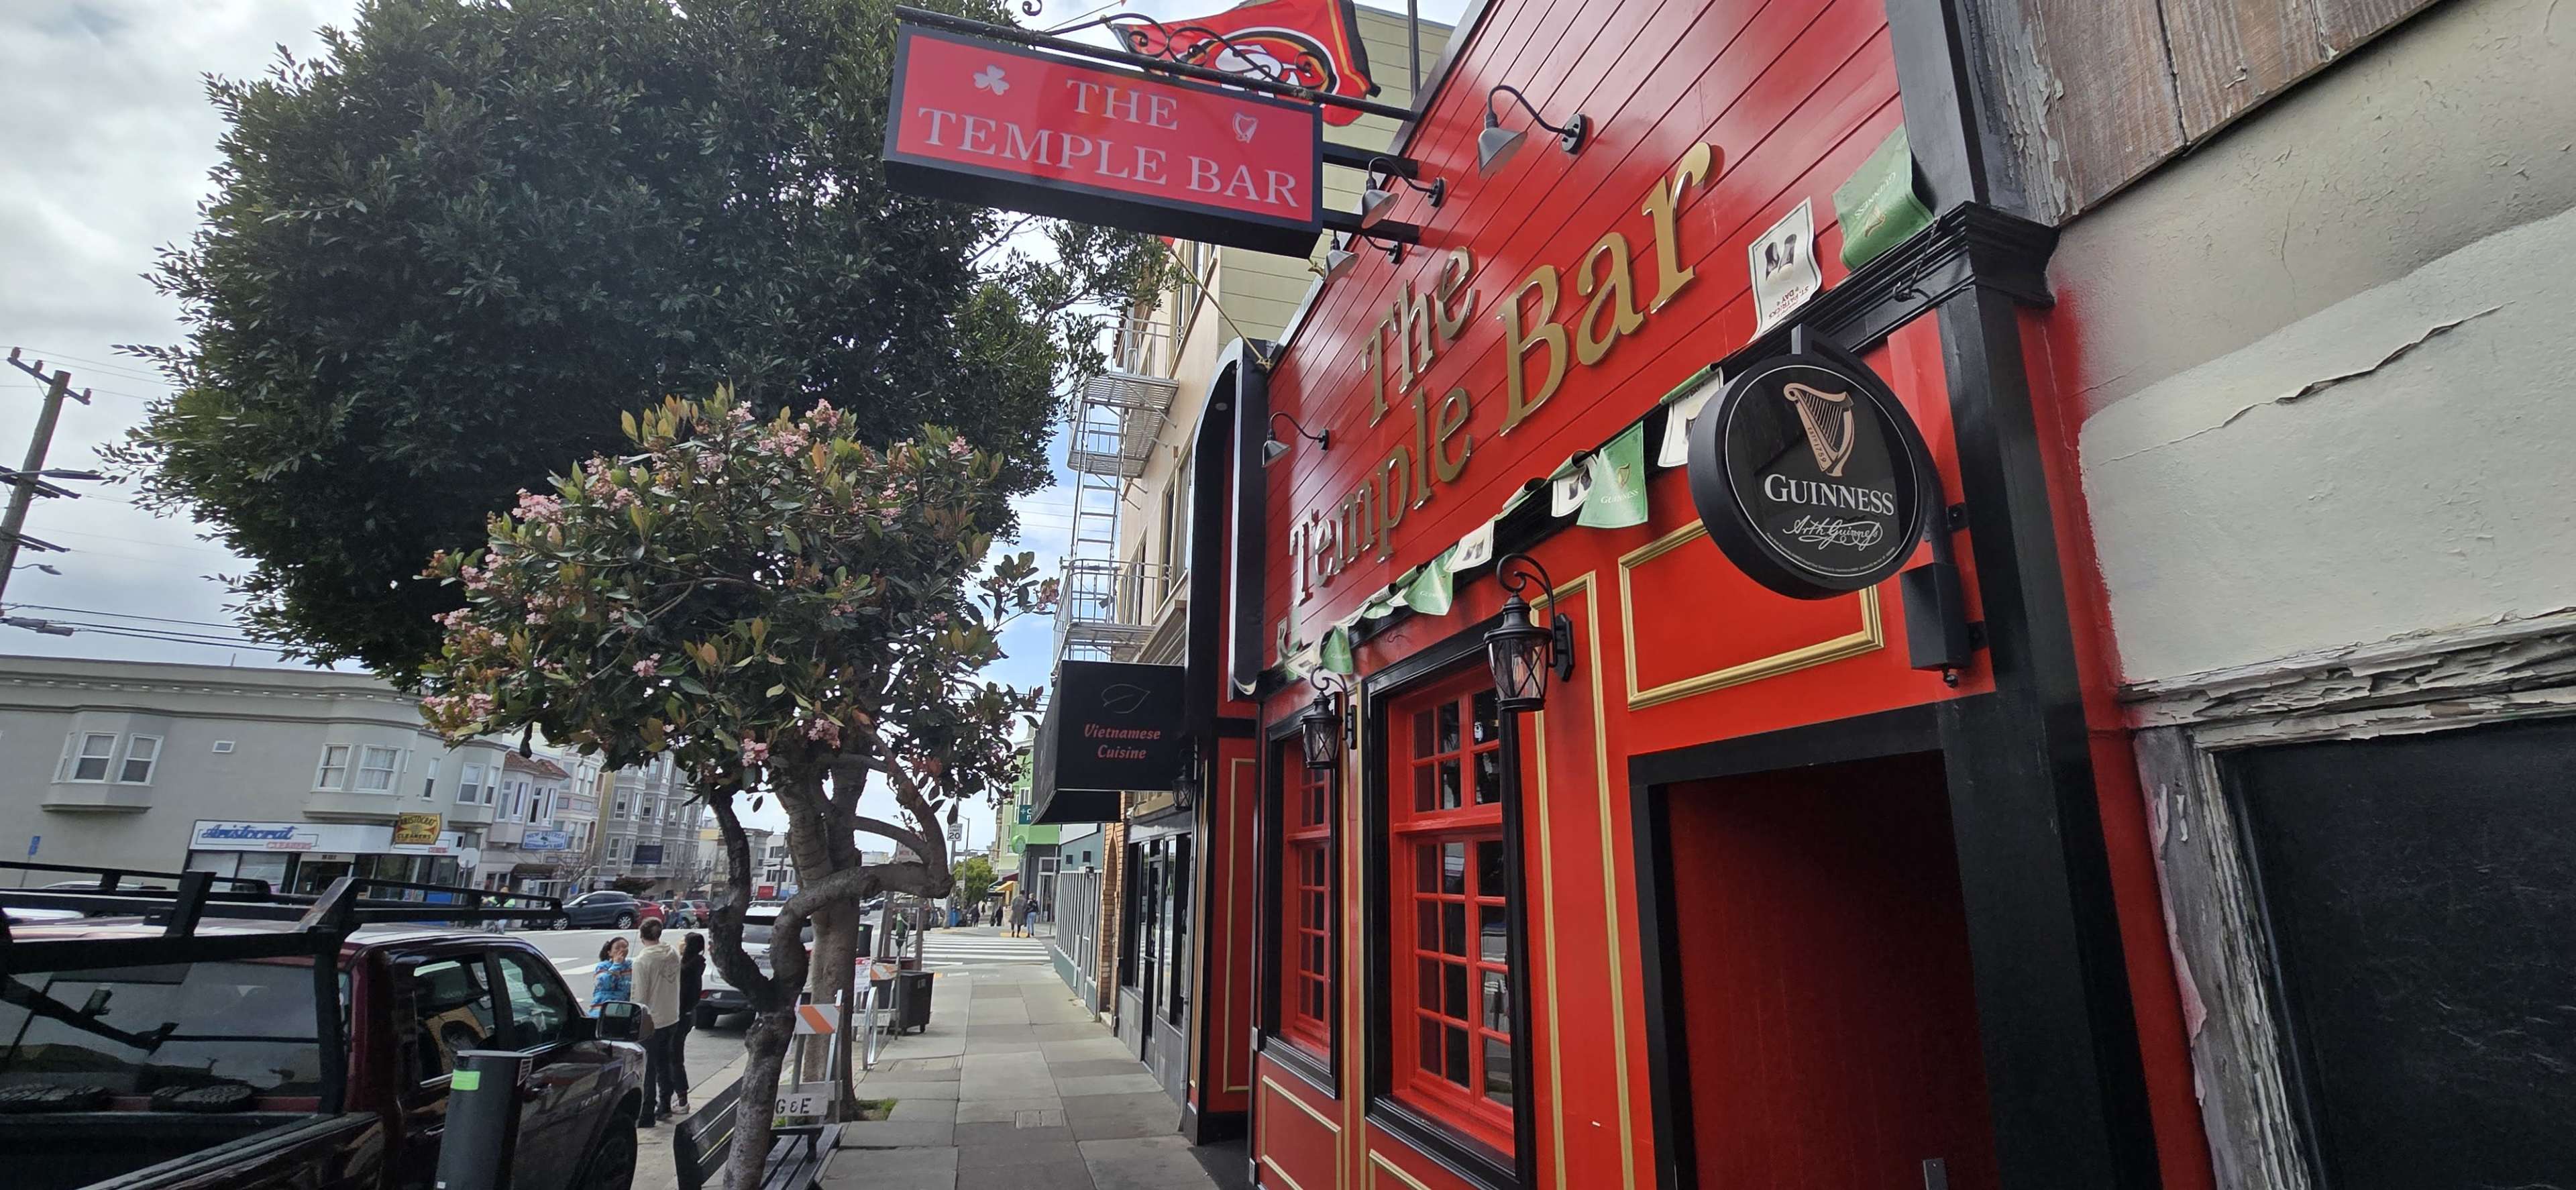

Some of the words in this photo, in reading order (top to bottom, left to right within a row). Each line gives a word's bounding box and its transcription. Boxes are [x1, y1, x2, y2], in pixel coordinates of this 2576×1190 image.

[1067, 78, 1179, 131] THE
[917, 107, 1167, 185] TEMPLE
[1187, 155, 1299, 209] BAR
[1360, 246, 1476, 428] The
[1289, 386, 1472, 608] Temple
[1495, 141, 1712, 437] Bar
[1814, 443, 1827, 462] 1759
[1764, 474, 1894, 516] GUINNESS
[1083, 723, 1161, 739] Vietnamese
[1097, 744, 1147, 759] Cuisine
[202, 824, 299, 840] Aristocrat
